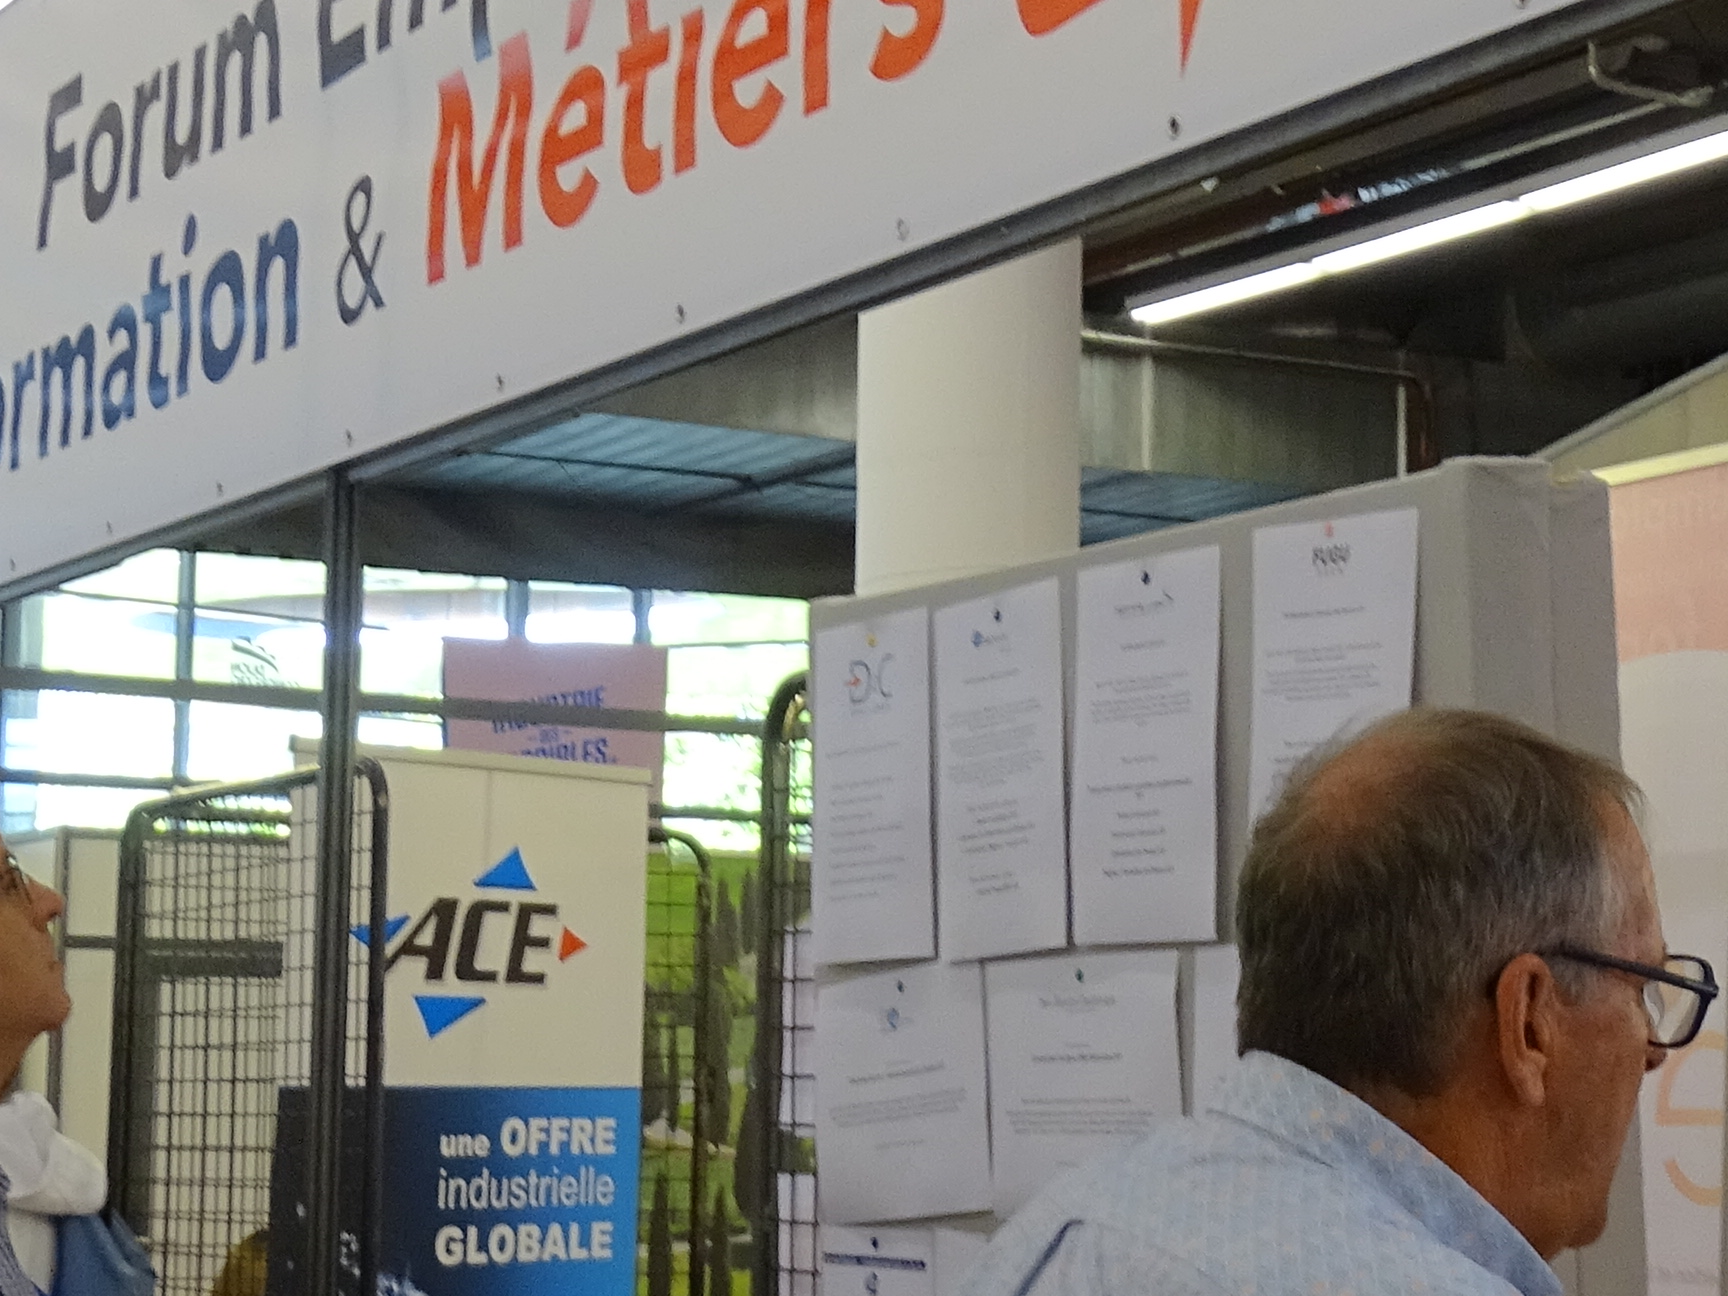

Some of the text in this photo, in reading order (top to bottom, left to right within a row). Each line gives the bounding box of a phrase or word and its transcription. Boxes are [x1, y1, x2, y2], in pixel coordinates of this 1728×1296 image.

[335, 174, 387, 327] &
[383, 896, 559, 986] ACE
[439, 1115, 618, 1159] une OFFRE
[437, 1166, 616, 1212] industrielle
[434, 1220, 614, 1268] GLOBALE
